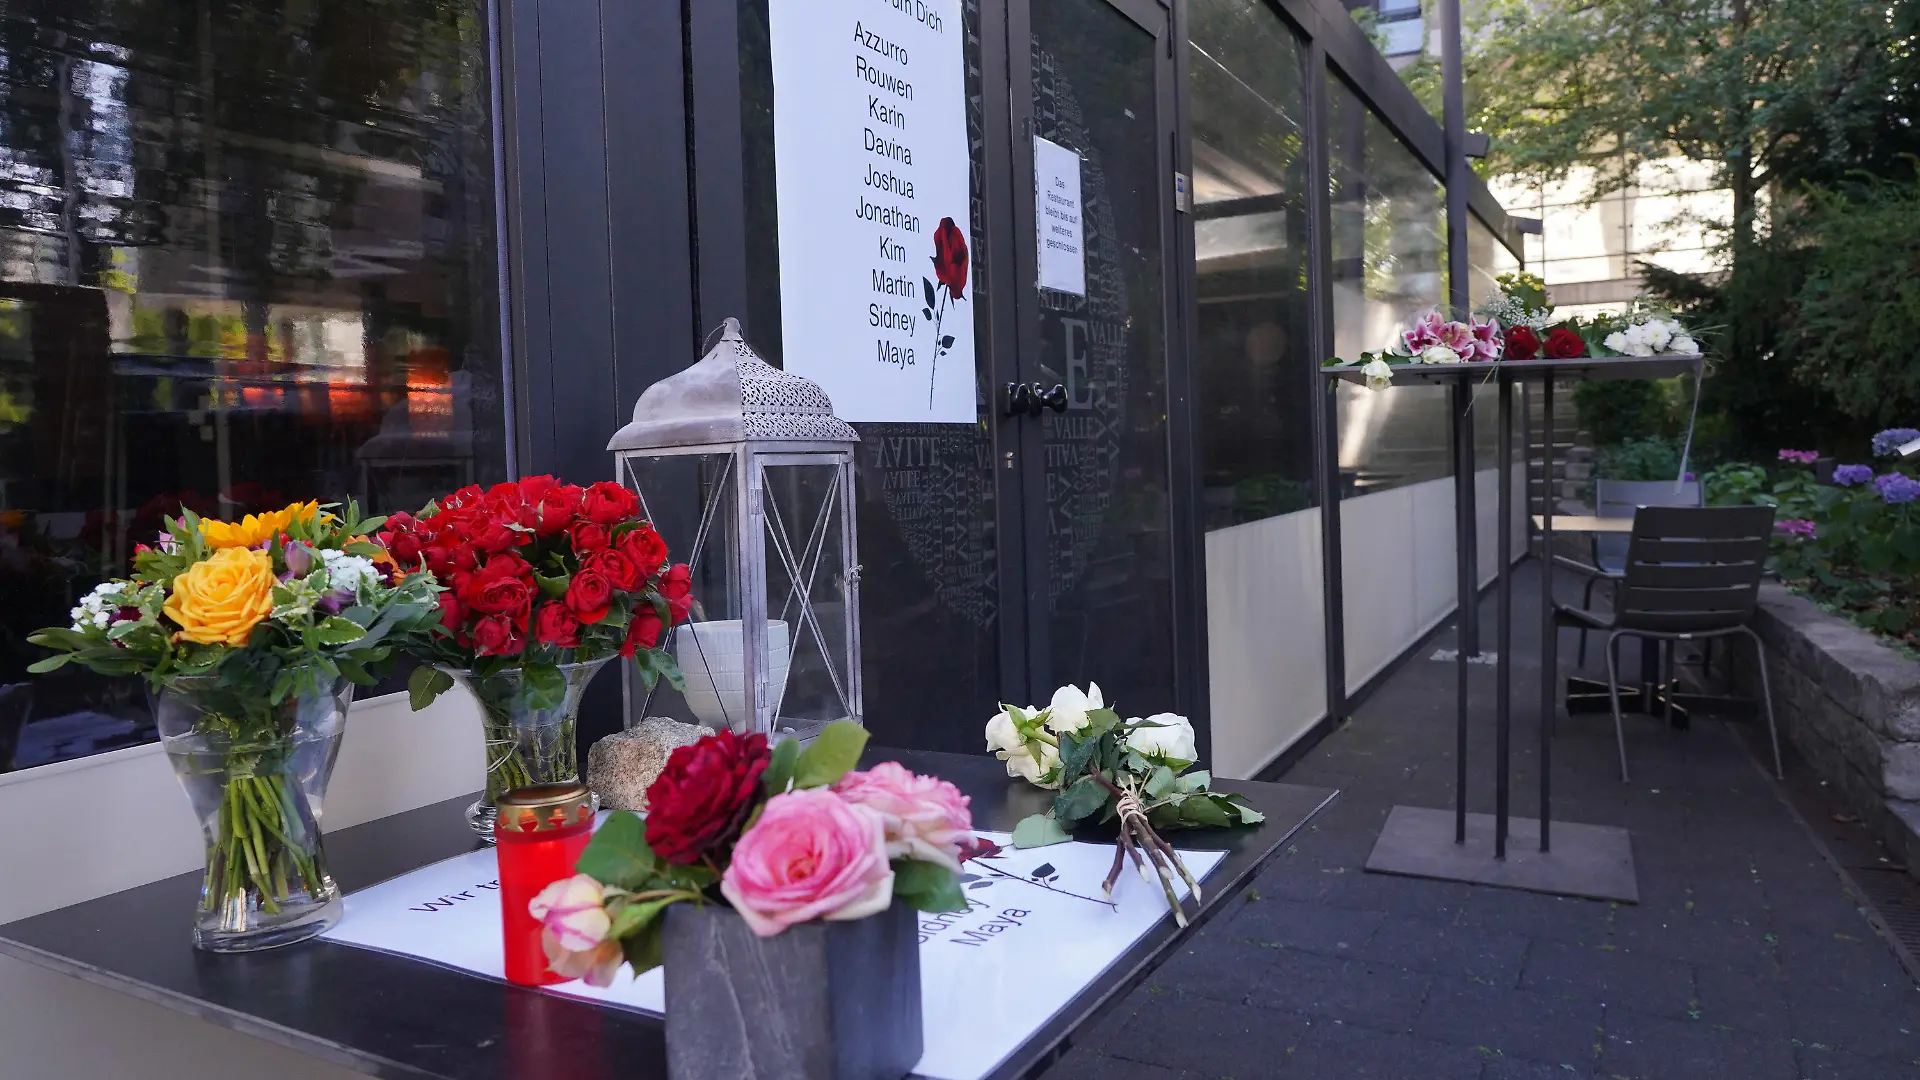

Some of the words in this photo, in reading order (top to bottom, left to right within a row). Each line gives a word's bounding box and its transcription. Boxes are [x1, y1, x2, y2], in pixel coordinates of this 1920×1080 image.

[917, 0, 943, 34] Dich
[854, 21, 908, 65] Azzurro
[856, 55, 912, 101] Rouwen
[869, 95, 905, 130] Karin
[864, 128, 912, 166] Davina
[864, 164, 914, 199] Joshua
[1055, 176, 1065, 189] Das
[856, 196, 919, 233] Jonathan
[1045, 205, 1060, 218] bleibt
[1060, 210, 1069, 221] bis
[1047, 190, 1075, 208] Restaurant
[1046, 238, 1078, 254] geschlossen
[1051, 224, 1073, 238] weiteres
[880, 236, 906, 263] Kim
[873, 269, 914, 298] Martin
[870, 303, 915, 337] Sidney
[878, 340, 915, 371] Maya
[408, 890, 475, 912] Wir
[950, 908, 1032, 947] Maya
